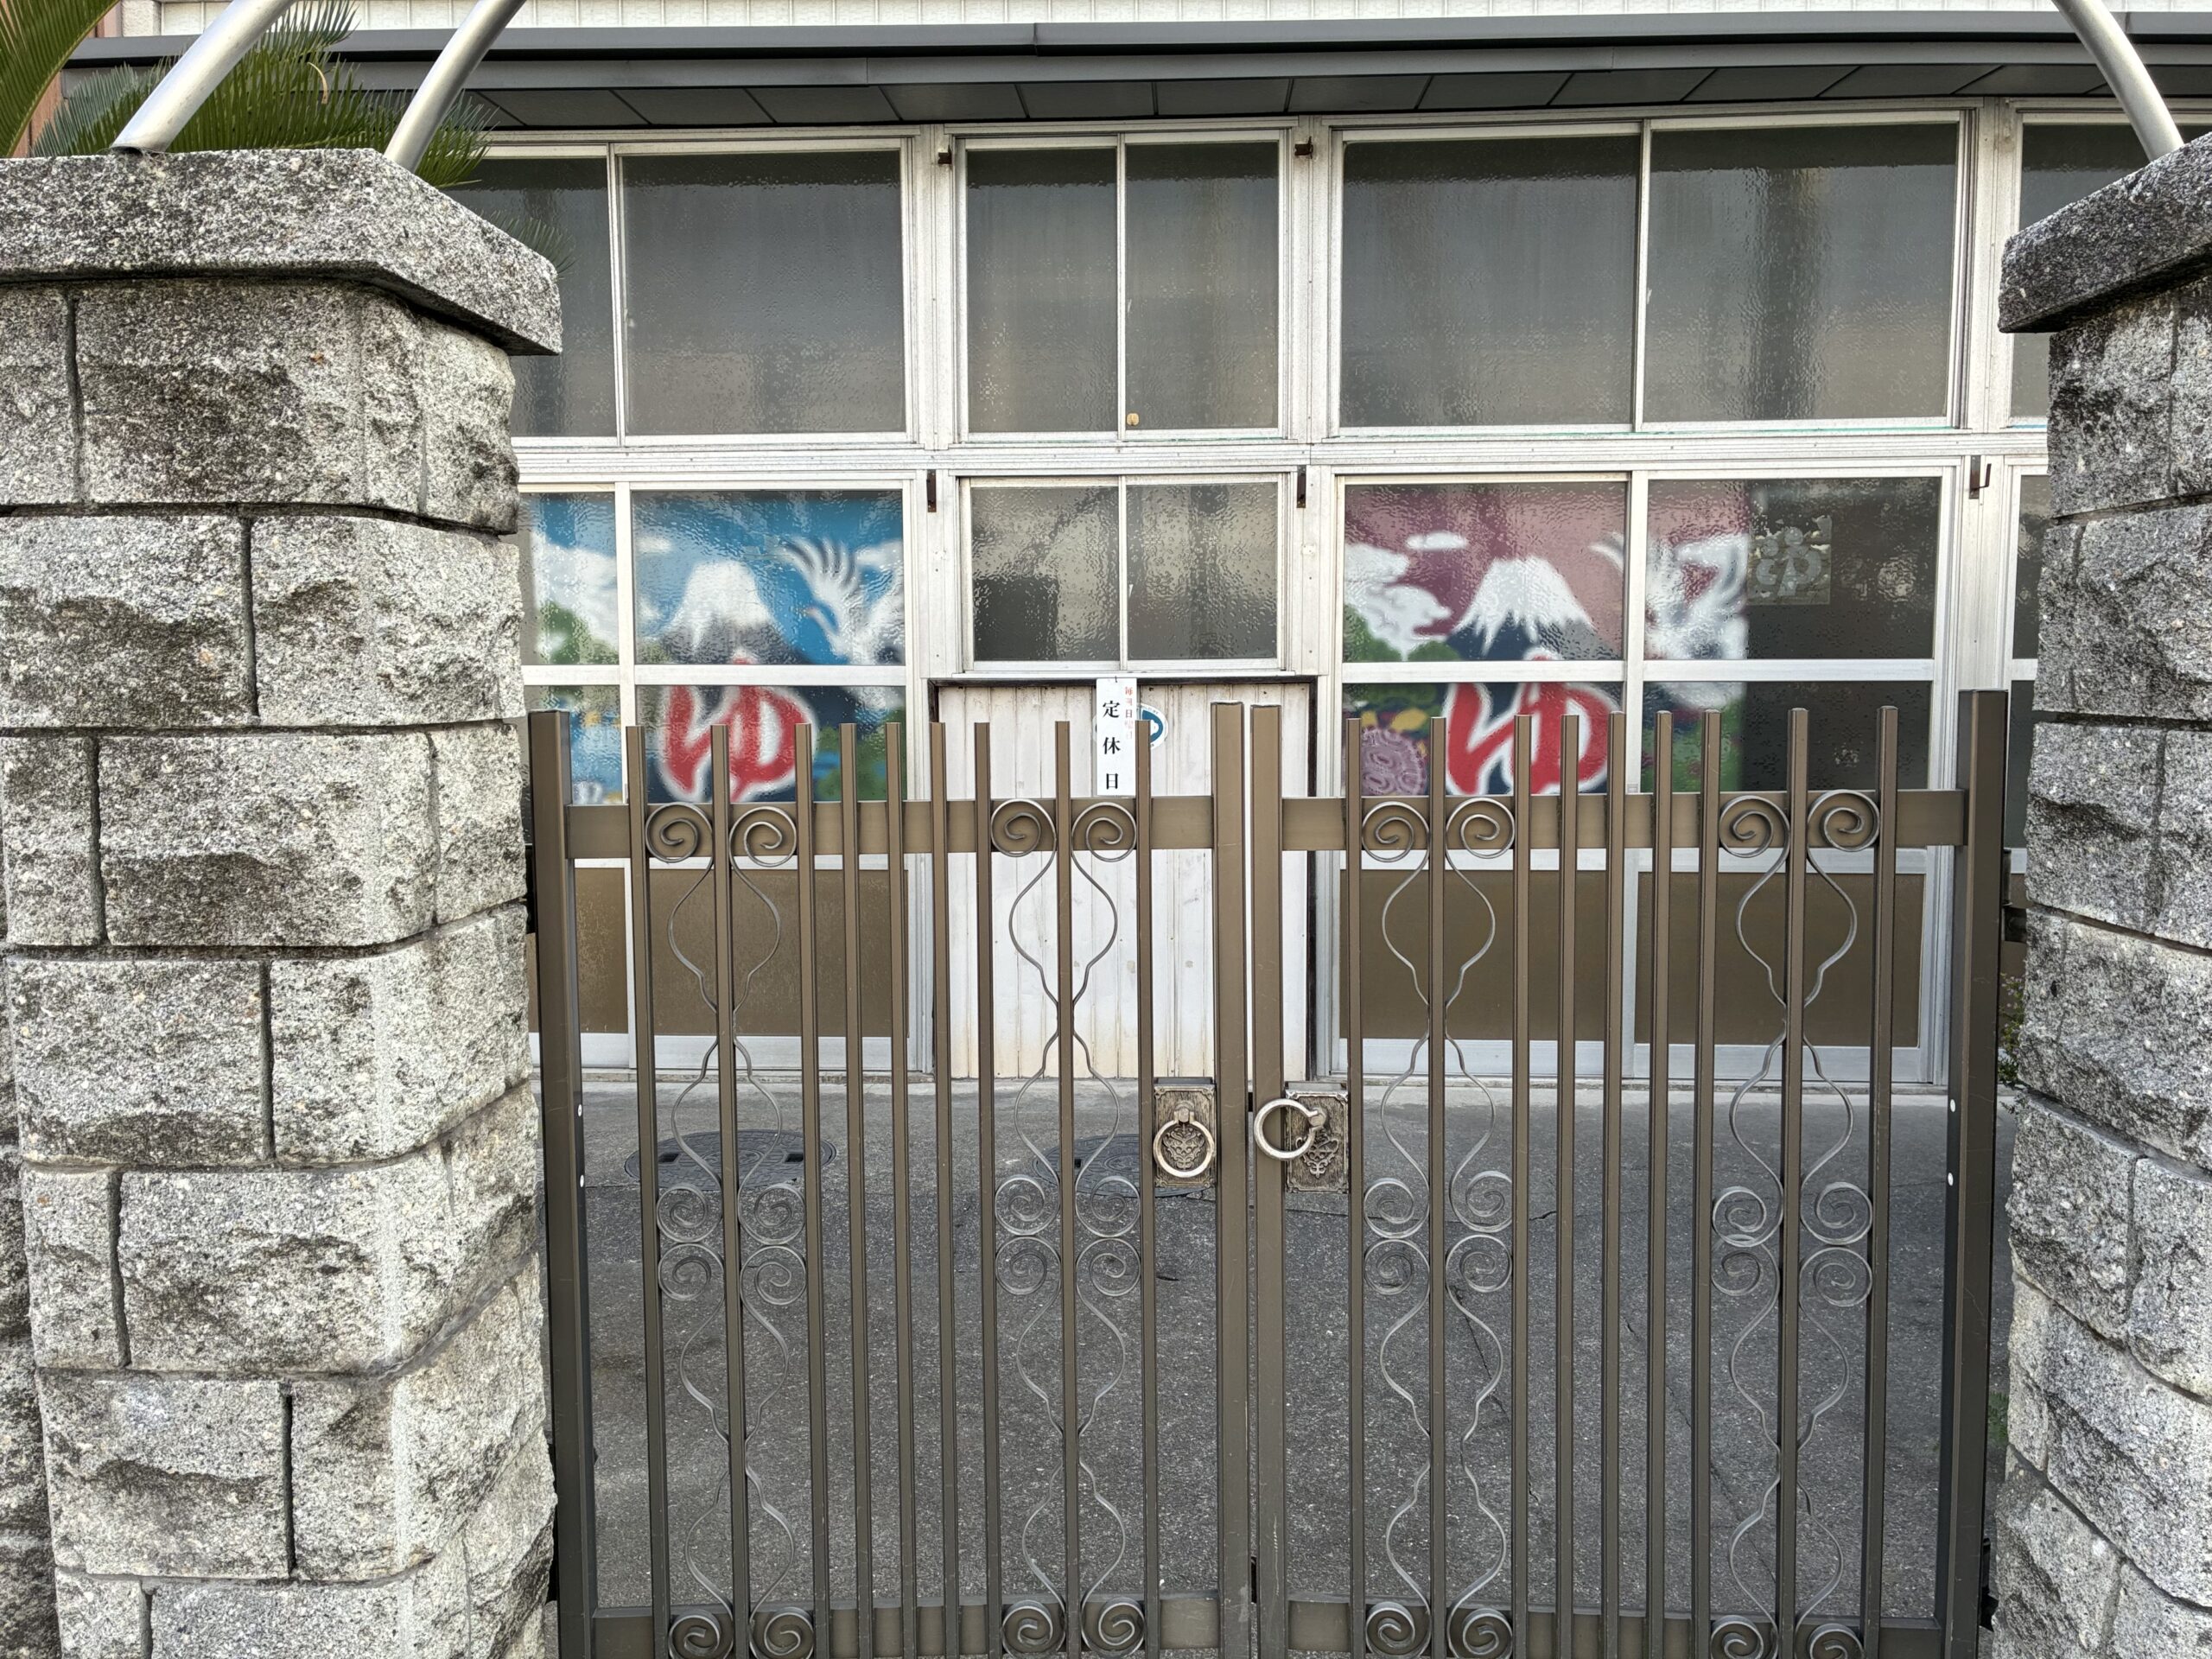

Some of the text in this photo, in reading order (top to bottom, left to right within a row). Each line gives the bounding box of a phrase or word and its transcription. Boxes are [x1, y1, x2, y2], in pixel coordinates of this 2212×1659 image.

[664, 655, 812, 802] ゆ
[1103, 700, 1121, 790] 定休日
[1446, 649, 1614, 796] ゆ
